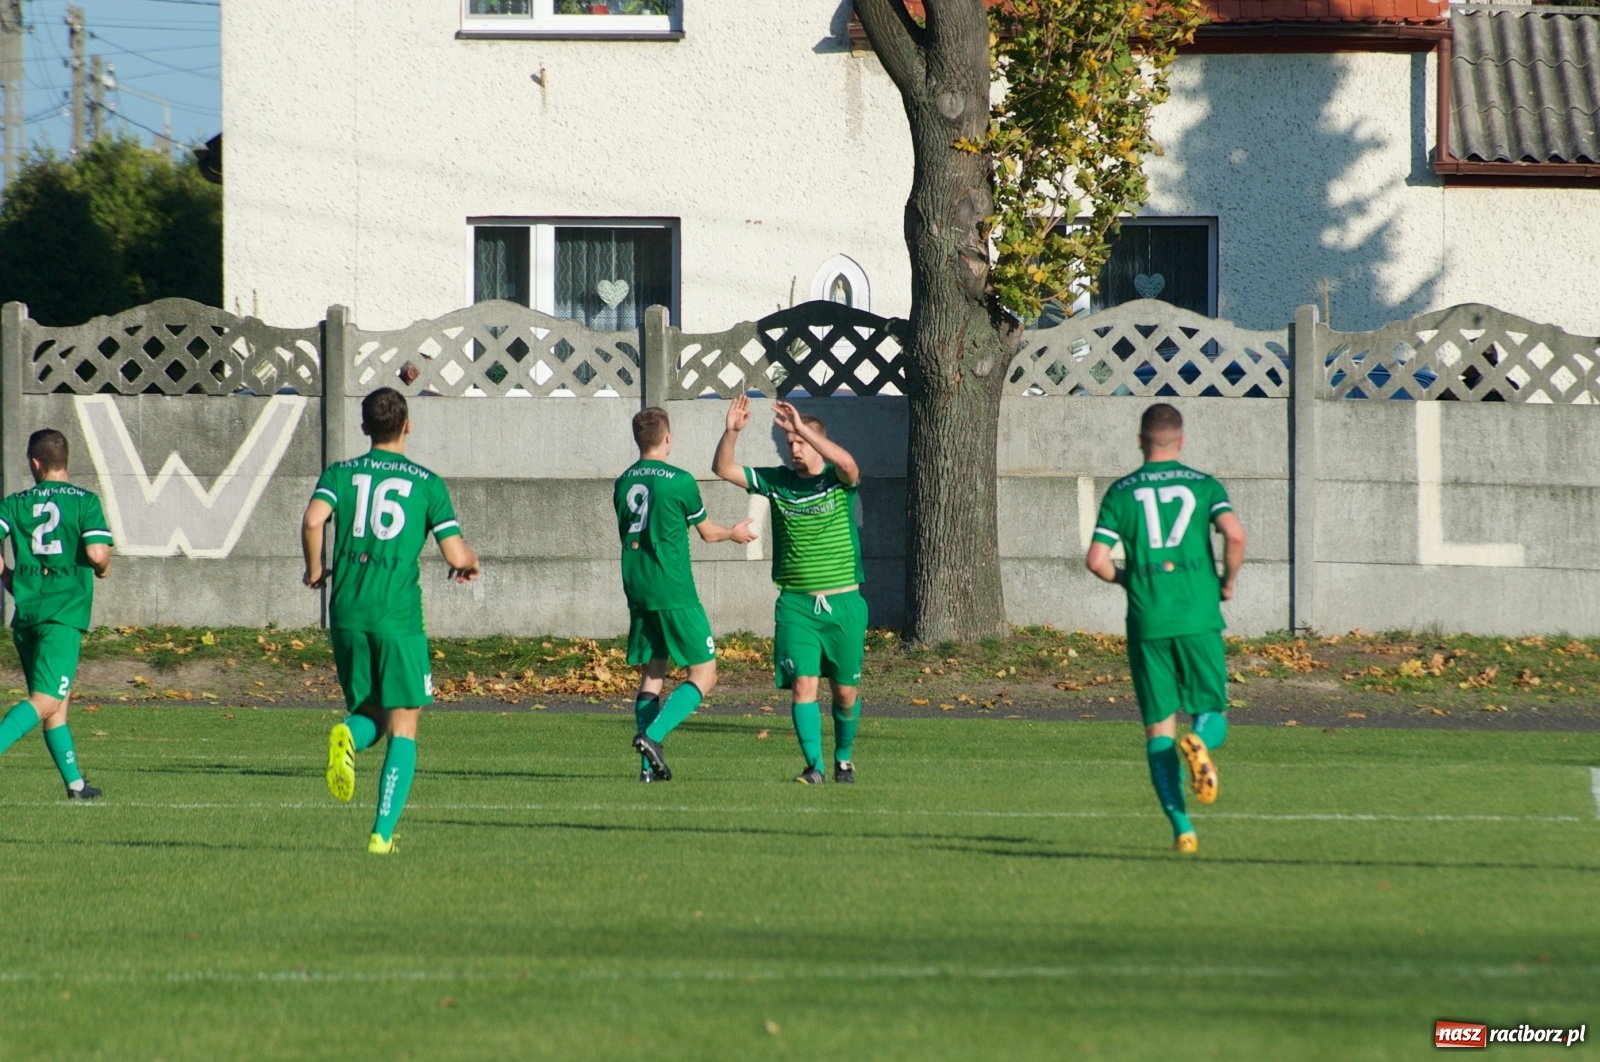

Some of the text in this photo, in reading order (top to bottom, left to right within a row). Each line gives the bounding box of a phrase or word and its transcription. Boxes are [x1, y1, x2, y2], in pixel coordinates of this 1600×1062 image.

[74, 394, 308, 559] W
[31, 501, 63, 555] 2
[352, 473, 413, 540] 16
[626, 483, 649, 534] 9
[1132, 484, 1197, 550] 17
[706, 636, 716, 655] 9
[57, 675, 70, 697] 2
